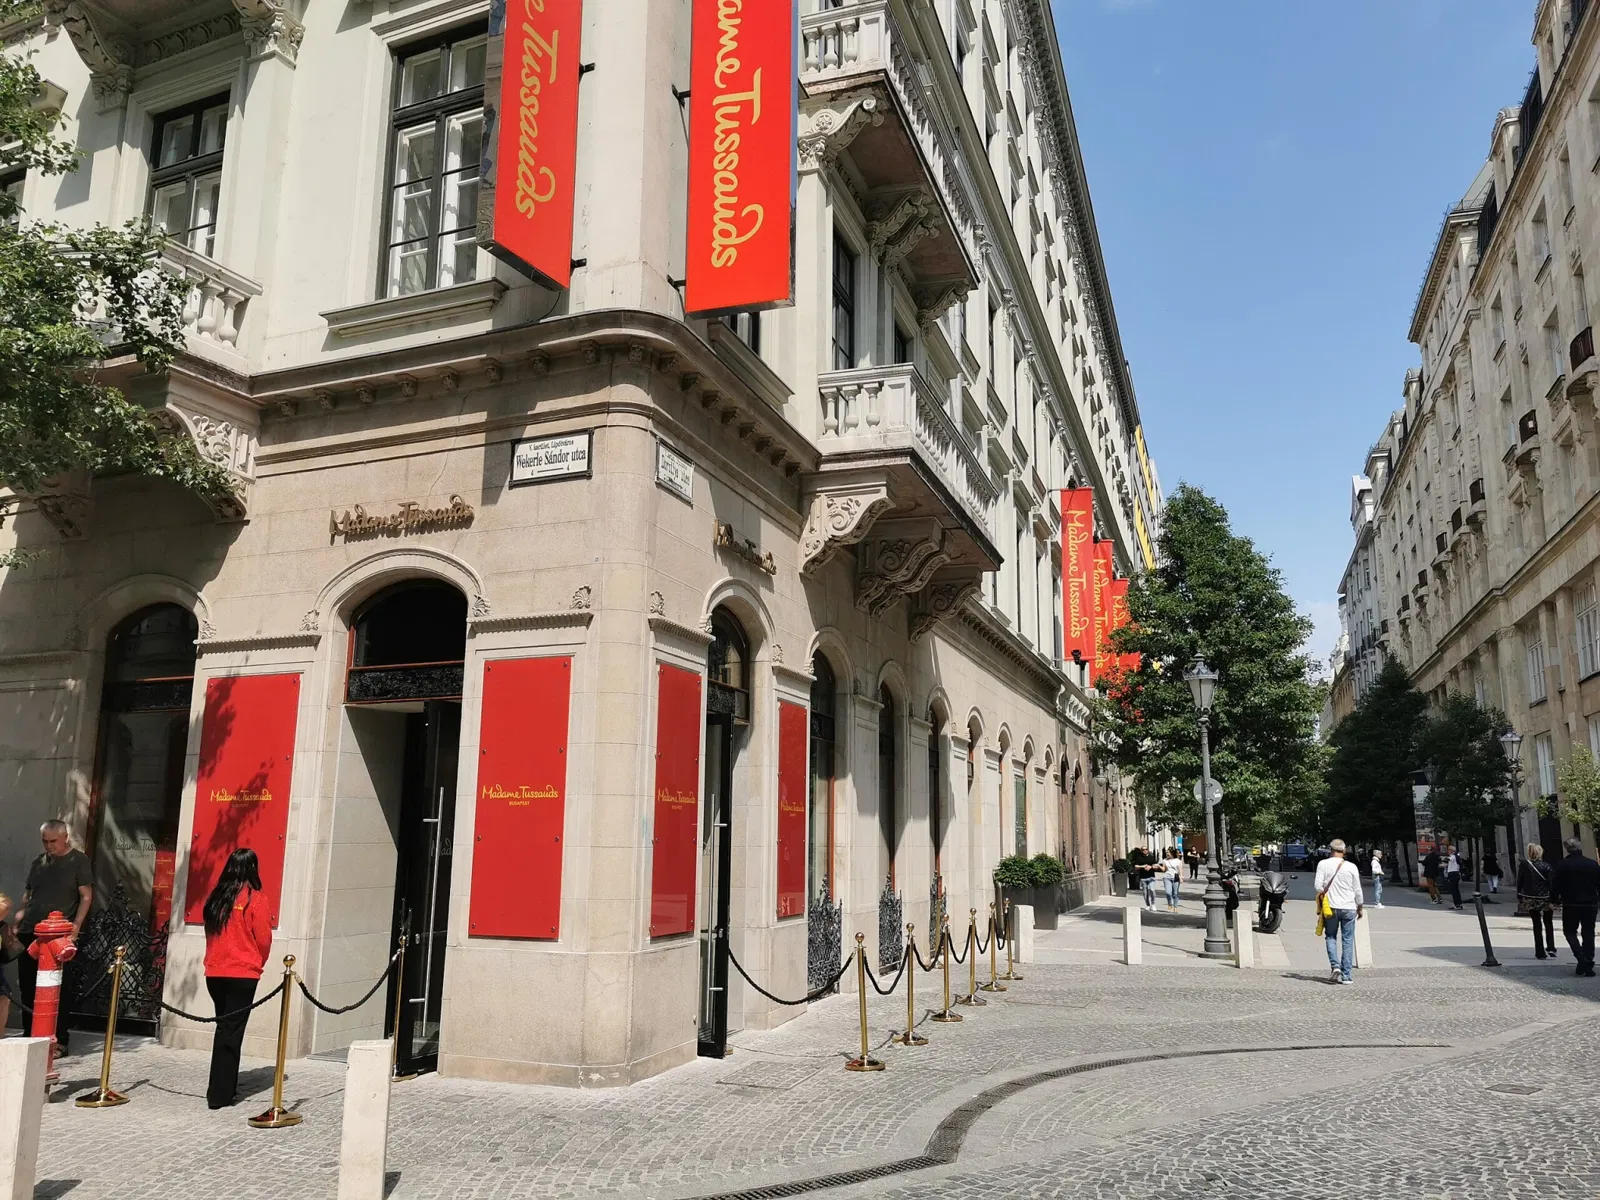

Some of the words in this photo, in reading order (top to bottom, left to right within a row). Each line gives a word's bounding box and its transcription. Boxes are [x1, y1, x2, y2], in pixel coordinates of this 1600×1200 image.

[515, 22, 559, 220] Tussauds
[711, 67, 764, 268] Tussauds
[516, 452, 542, 469] Wekerle
[544, 449, 570, 465] Sándor
[571, 446, 586, 461] utca
[328, 503, 401, 535] Madame
[397, 493, 475, 525] Tussauds
[1067, 509, 1088, 576] Madame
[1068, 571, 1090, 638] Tussauds
[1093, 558, 1109, 612] Madame
[210, 787, 241, 802] Madame
[240, 788, 272, 802] Tussauds
[482, 783, 521, 800] Madame
[518, 784, 559, 799] Tussauds
